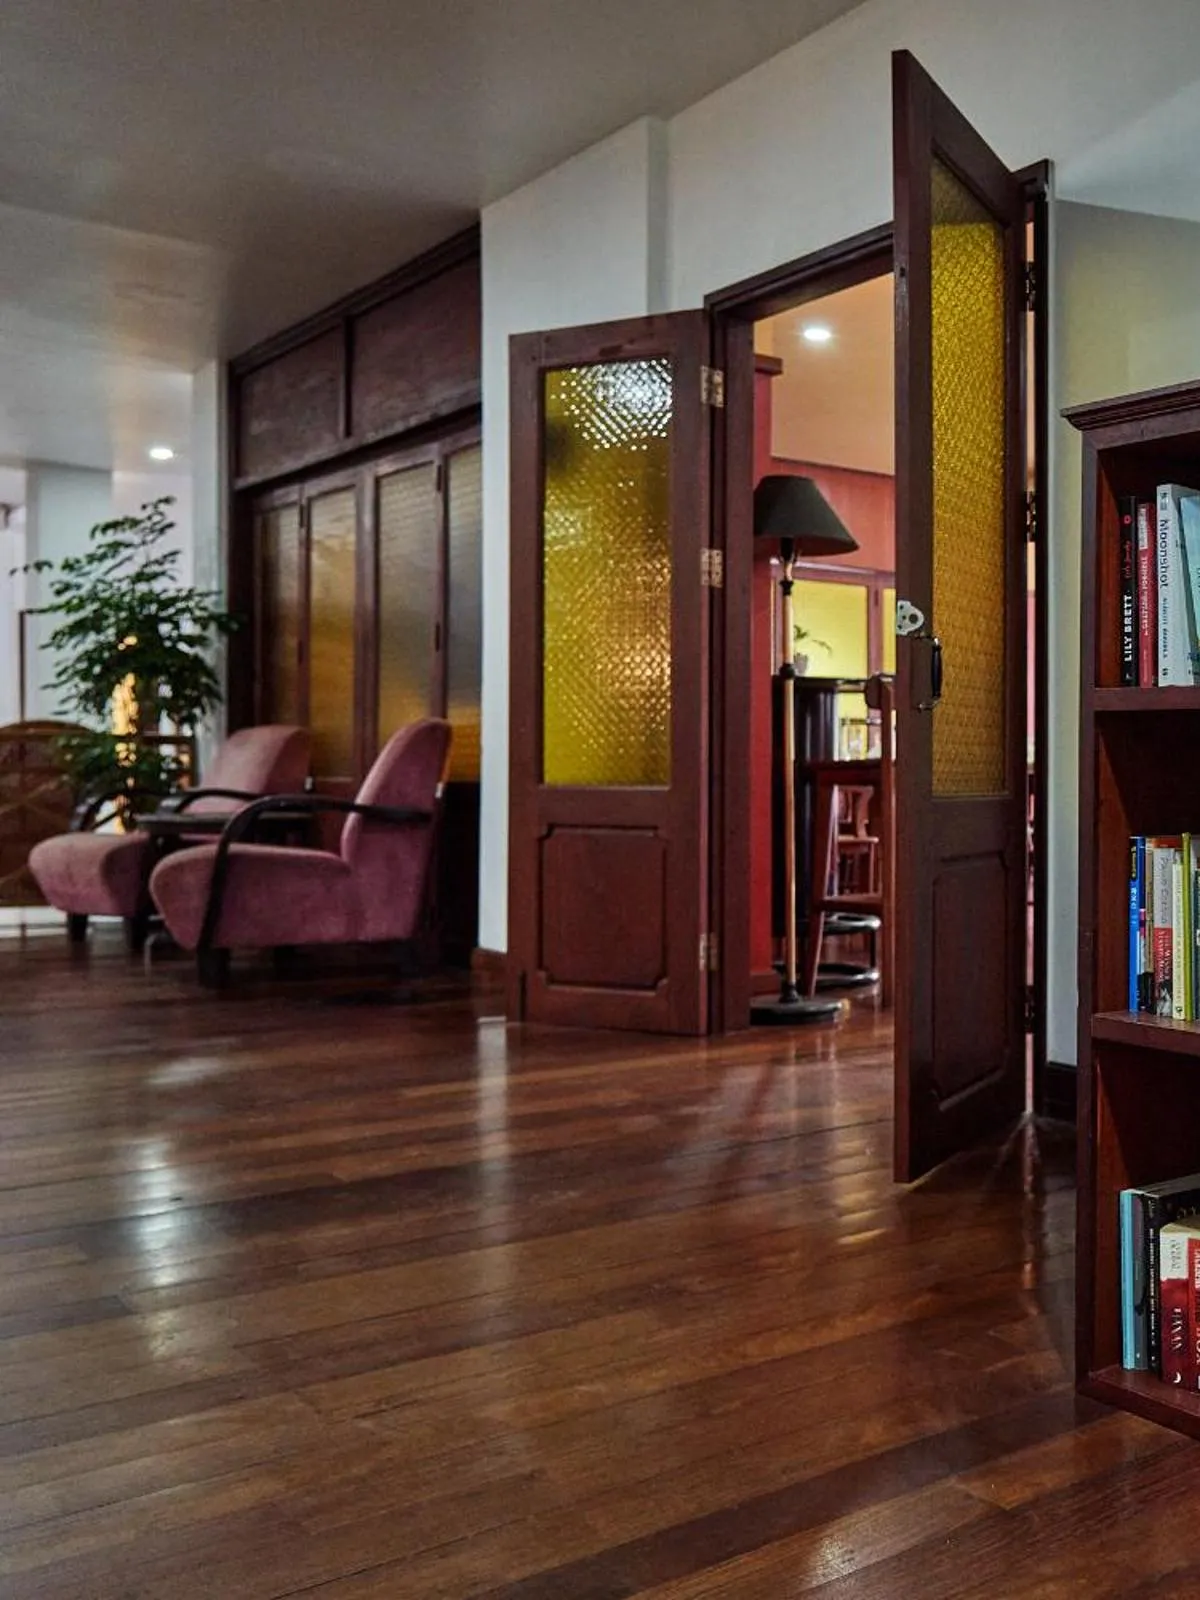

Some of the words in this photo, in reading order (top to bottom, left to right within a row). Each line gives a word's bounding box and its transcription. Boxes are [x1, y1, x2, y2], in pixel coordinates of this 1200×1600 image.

[1159, 519, 1171, 588] Moonshot
[1124, 595, 1132, 634] BRETT
[1124, 637, 1132, 662] LILY
